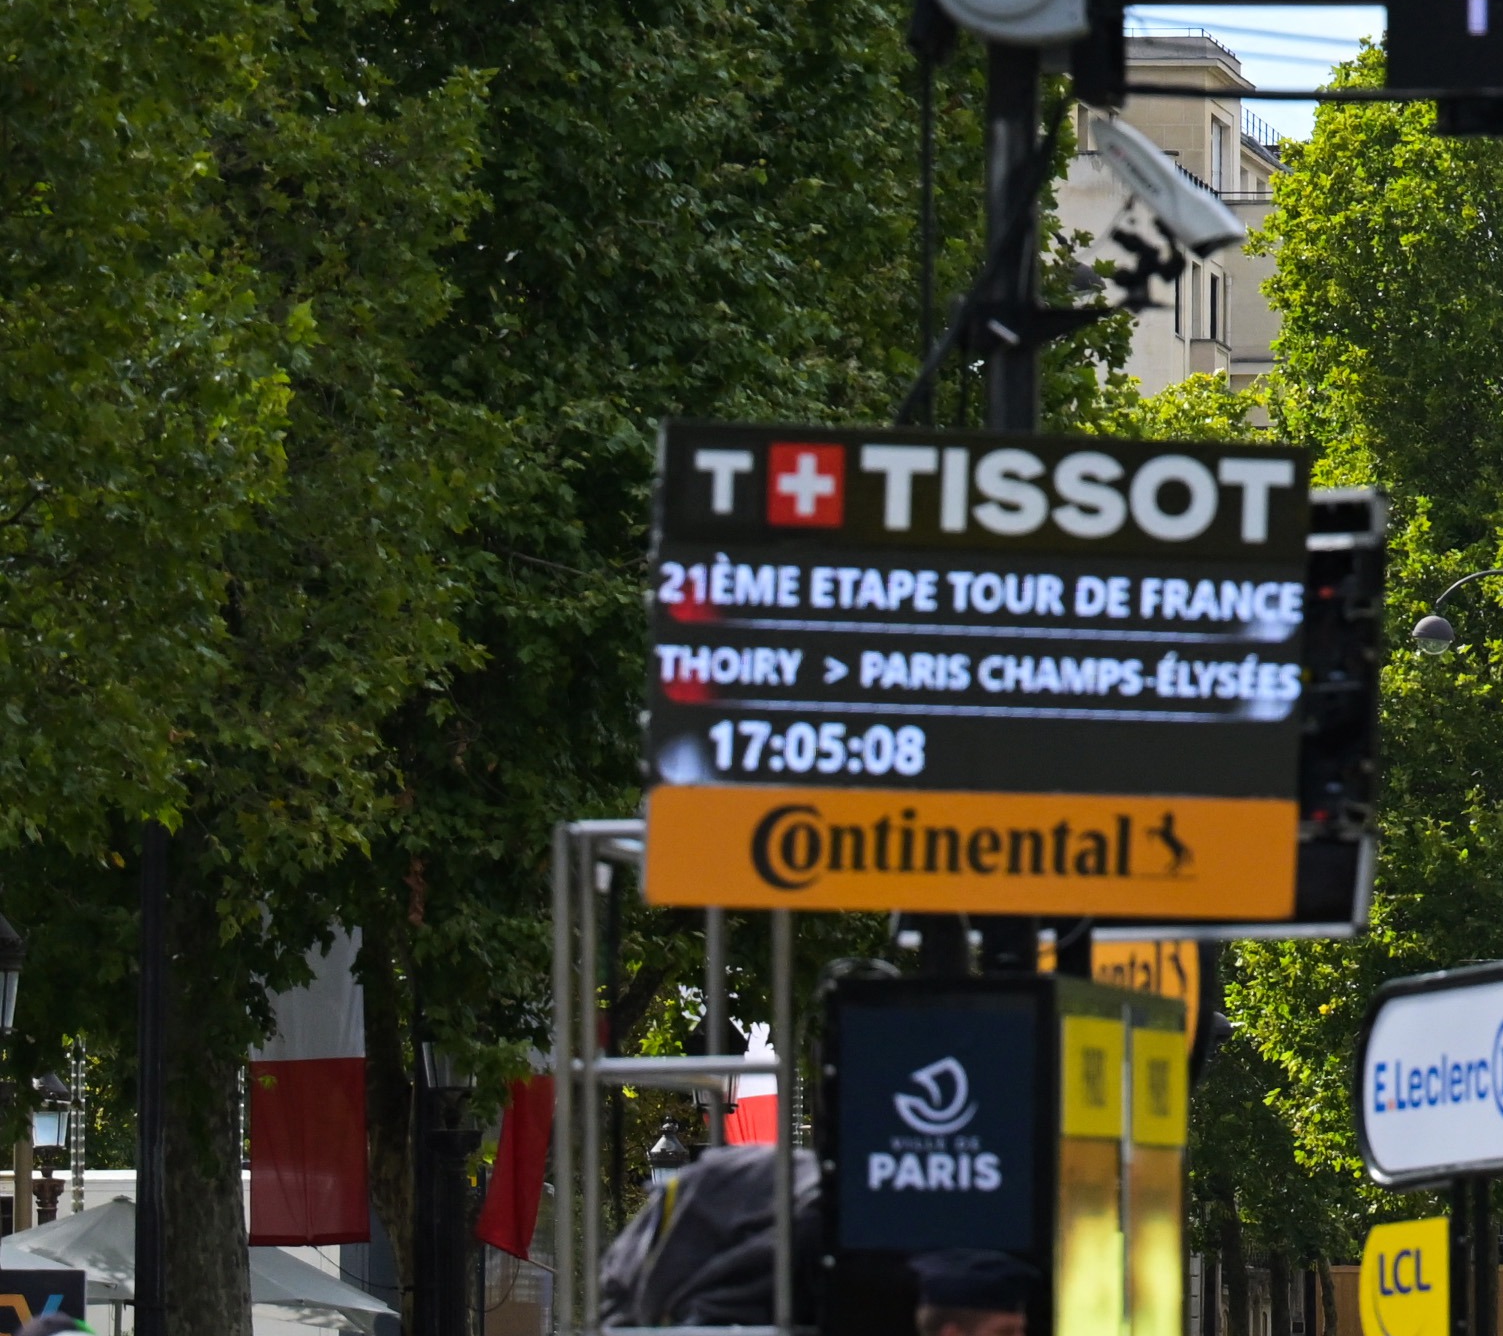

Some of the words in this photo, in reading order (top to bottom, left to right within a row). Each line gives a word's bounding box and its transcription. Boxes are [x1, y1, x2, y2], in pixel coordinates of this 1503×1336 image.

[860, 444, 1295, 543] TISSOT
[658, 552, 801, 608] 21ÈME
[809, 566, 938, 614] ETAPE
[948, 570, 1065, 616] TOUR
[1074, 575, 1131, 619] DE
[1140, 577, 1305, 624] FRANCE
[656, 644, 801, 687] THOIRY
[860, 650, 970, 692] PARIS
[978, 649, 1303, 702] CHAMPS-ÉLYSÉES
[708, 720, 928, 777] 17:05:08
[751, 803, 1131, 891] Continental
[1373, 1055, 1490, 1113] E.Leclerc
[867, 1152, 1003, 1192] PARIS
[1377, 1248, 1432, 1297] LCL
